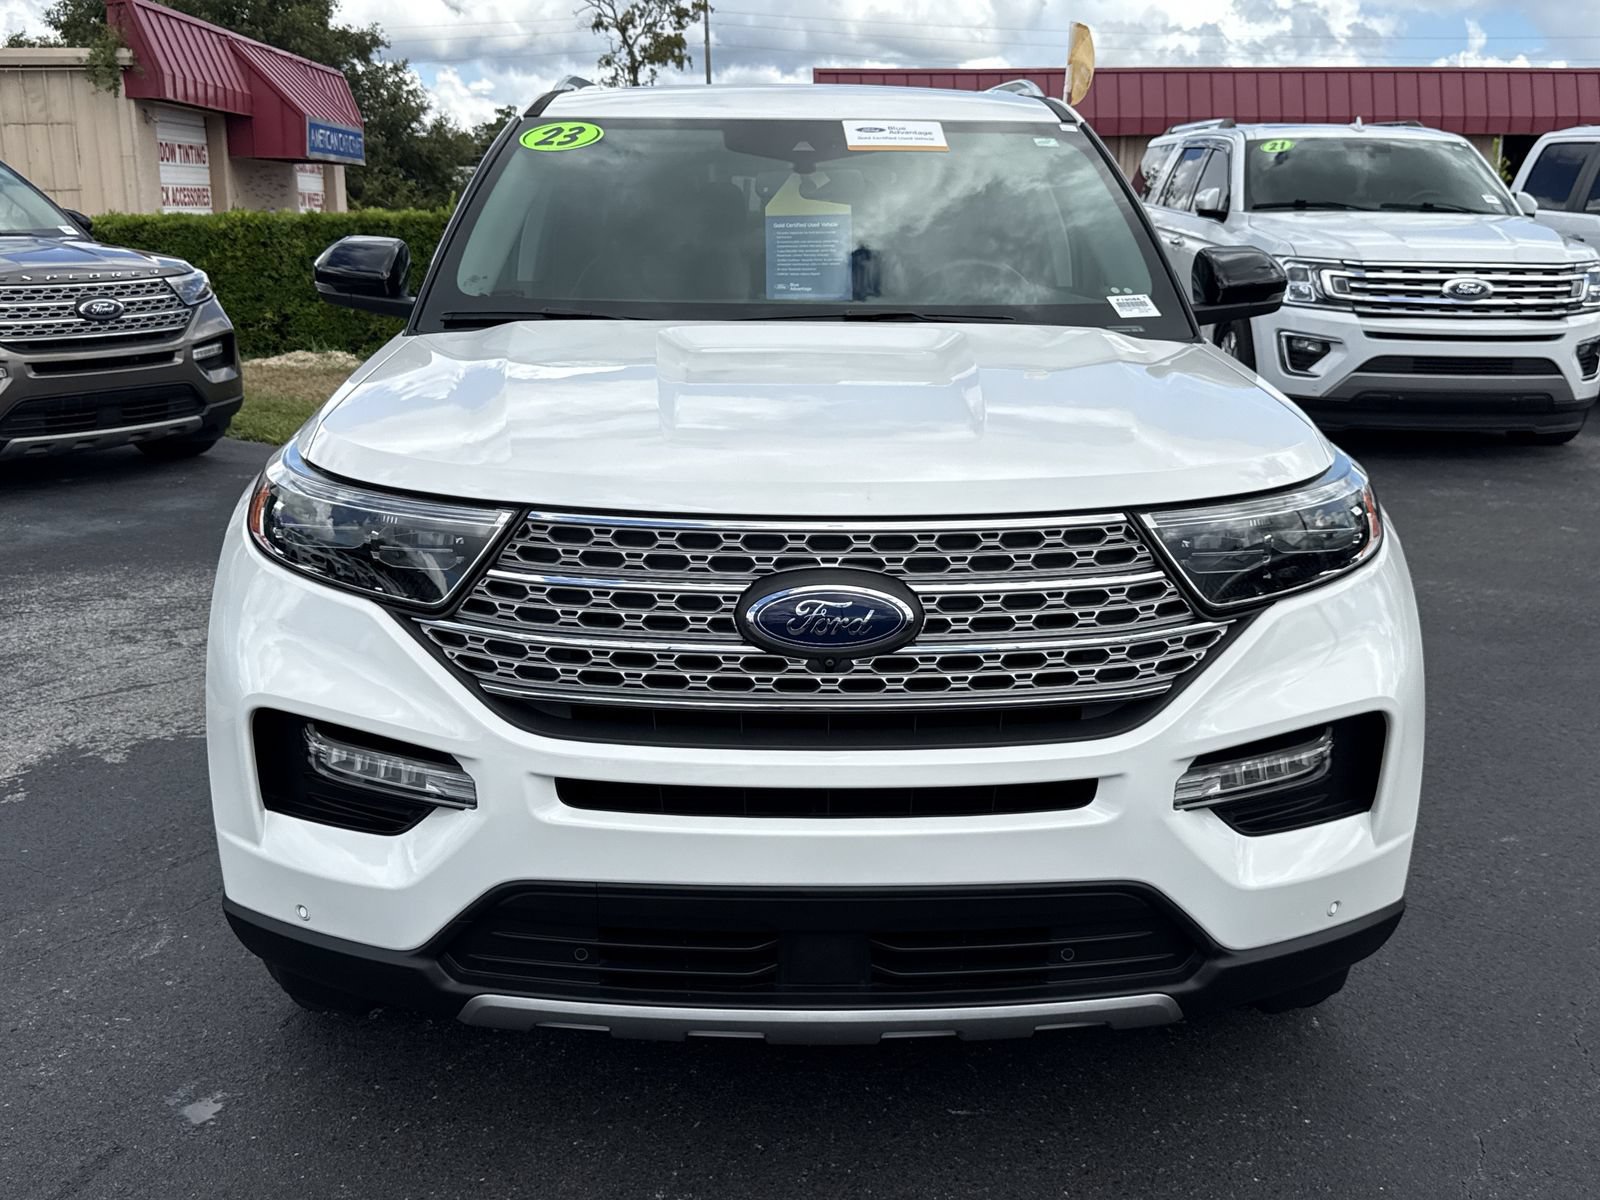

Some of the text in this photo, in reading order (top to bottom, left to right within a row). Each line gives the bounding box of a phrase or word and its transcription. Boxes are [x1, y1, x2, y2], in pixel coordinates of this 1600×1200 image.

[534, 126, 586, 146] 23
[1269, 141, 1286, 151] 21
[177, 144, 207, 165] TINTING
[172, 186, 210, 207] ACCESSORIES
[1456, 283, 1482, 294] Ford
[91, 302, 115, 314] Ford
[786, 599, 876, 636] Ford
